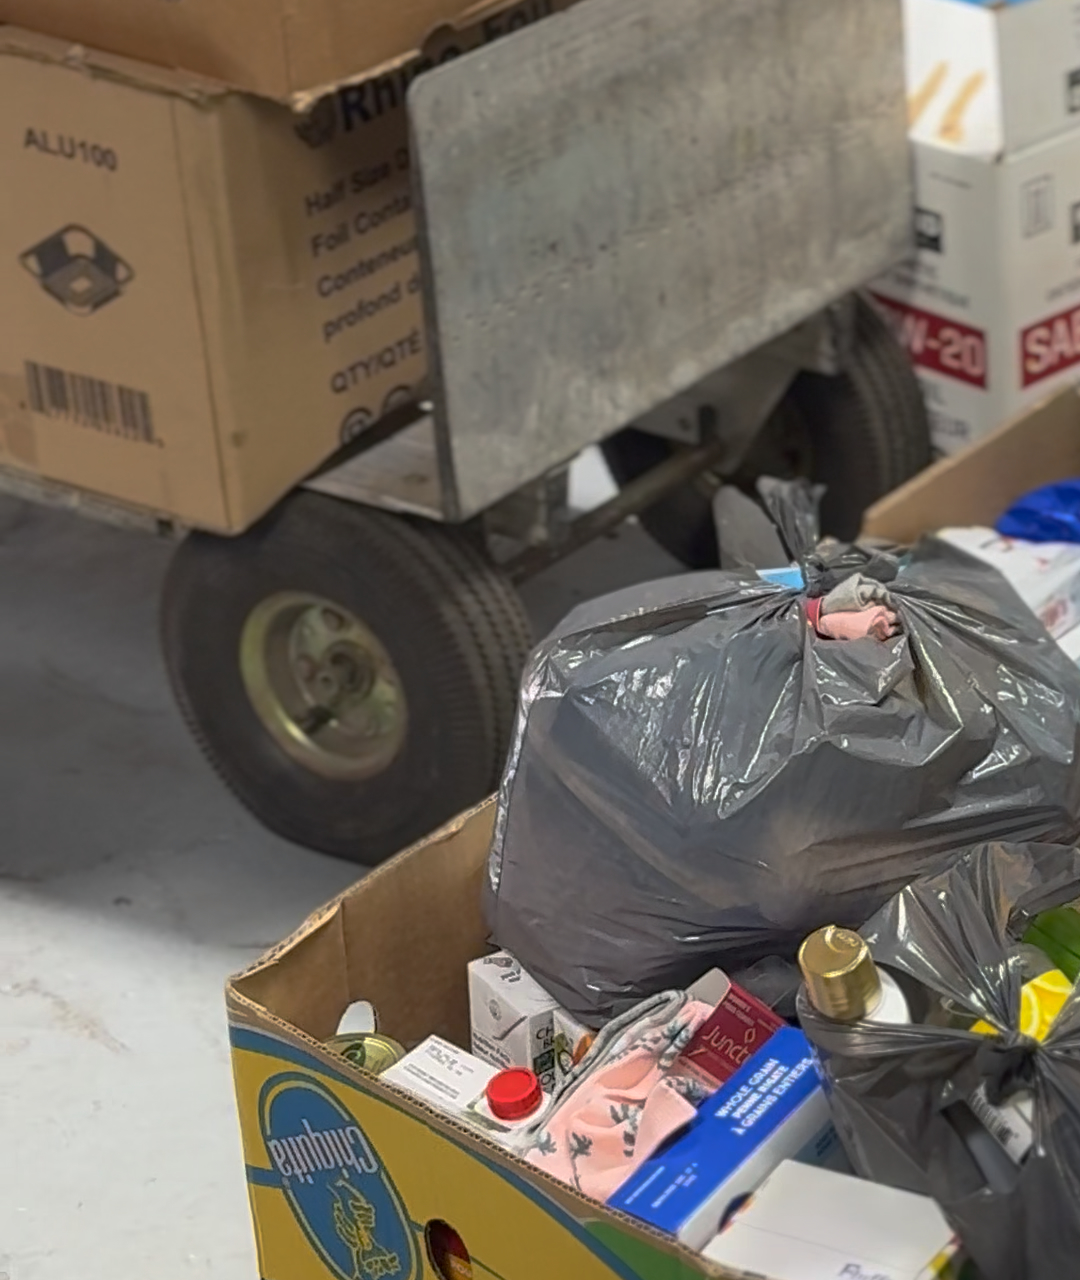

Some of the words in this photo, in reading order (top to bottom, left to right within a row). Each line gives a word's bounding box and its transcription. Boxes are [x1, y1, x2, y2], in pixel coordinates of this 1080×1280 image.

[23, 127, 119, 173] ALU100
[305, 177, 347, 217] Half
[310, 222, 350, 258] Foil
[354, 193, 412, 236] Conta
[317, 236, 418, 299] Conteneu
[322, 282, 402, 344] profond
[702, 1025, 751, 1064] Junct
[715, 1085, 753, 1118] WHOLE
[748, 1057, 781, 1086] GRAIN
[741, 1094, 778, 1127] GRAINS
[772, 1057, 814, 1096] ENTIERS
[268, 1118, 379, 1185] Chiquita
